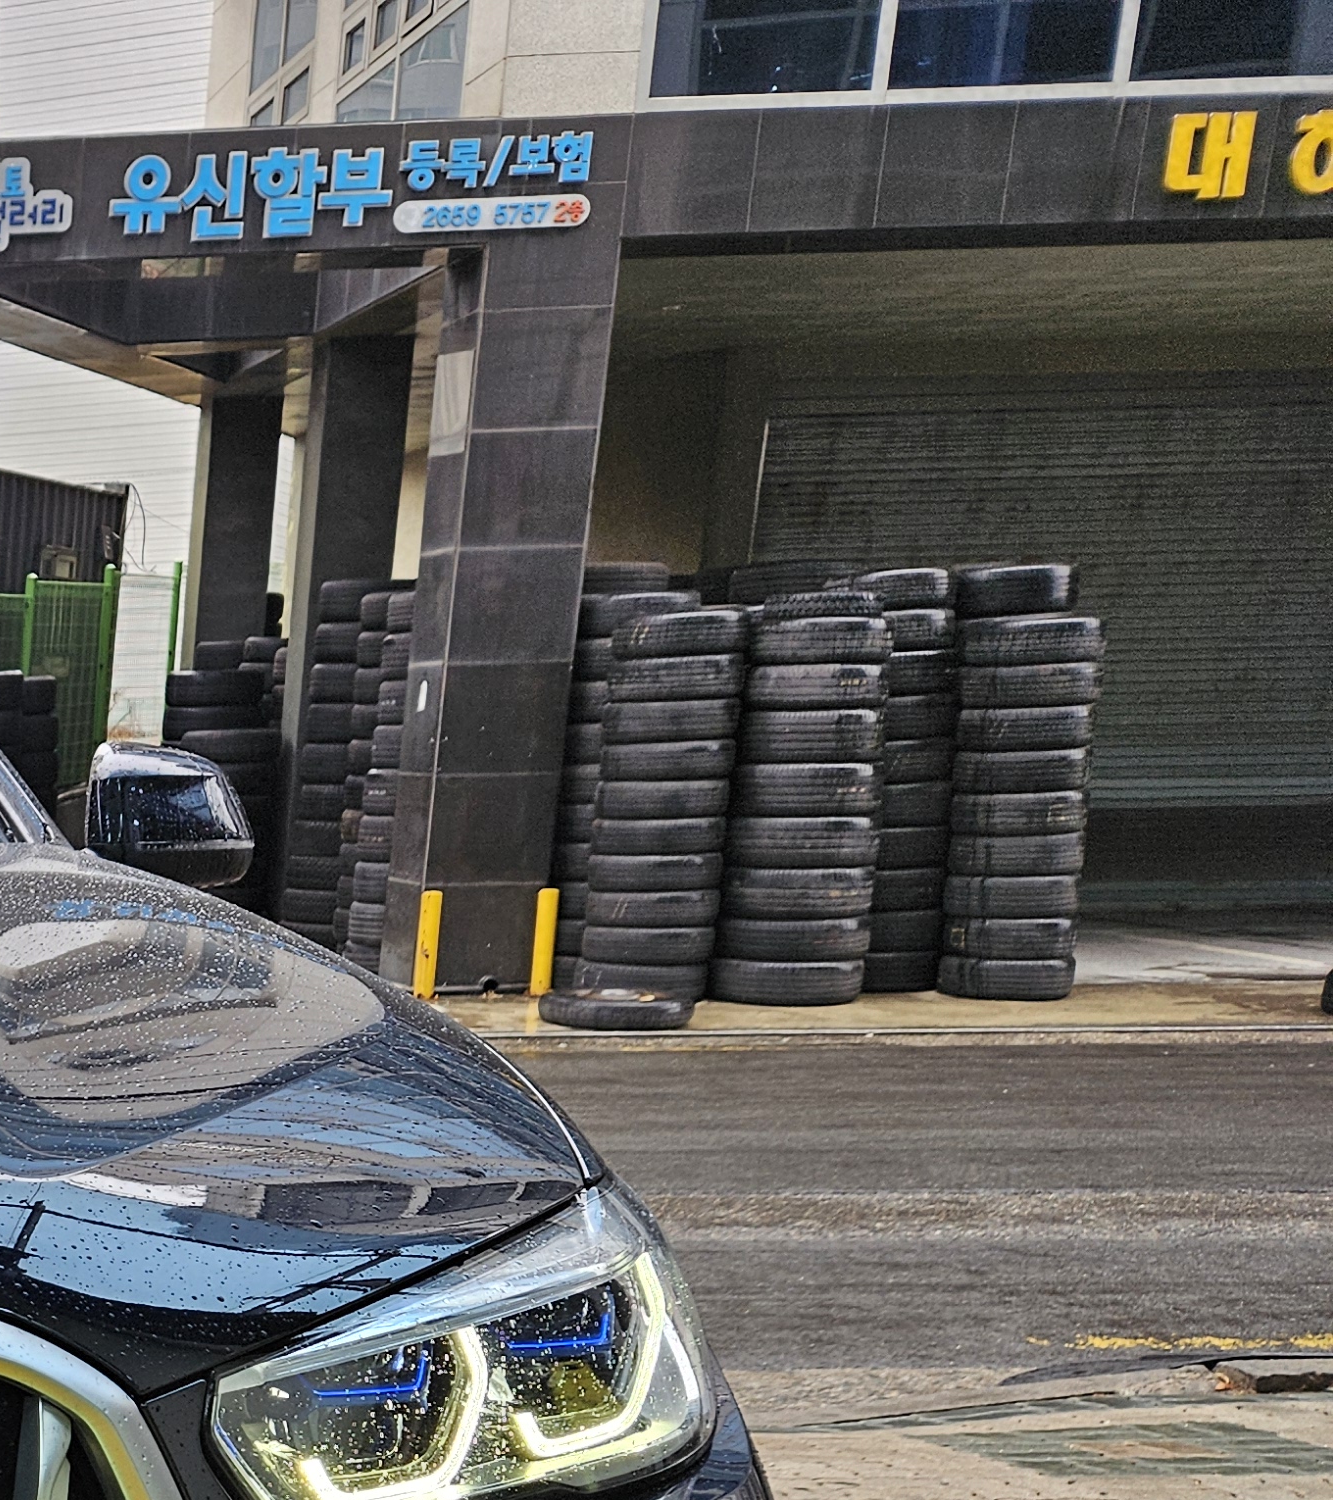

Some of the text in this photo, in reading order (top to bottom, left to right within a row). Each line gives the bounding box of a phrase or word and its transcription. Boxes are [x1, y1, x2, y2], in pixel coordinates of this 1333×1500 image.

[400, 131, 593, 191] 등록/보험
[109, 147, 393, 241] 유신할부
[422, 200, 585, 229] 2659 5757 2층
